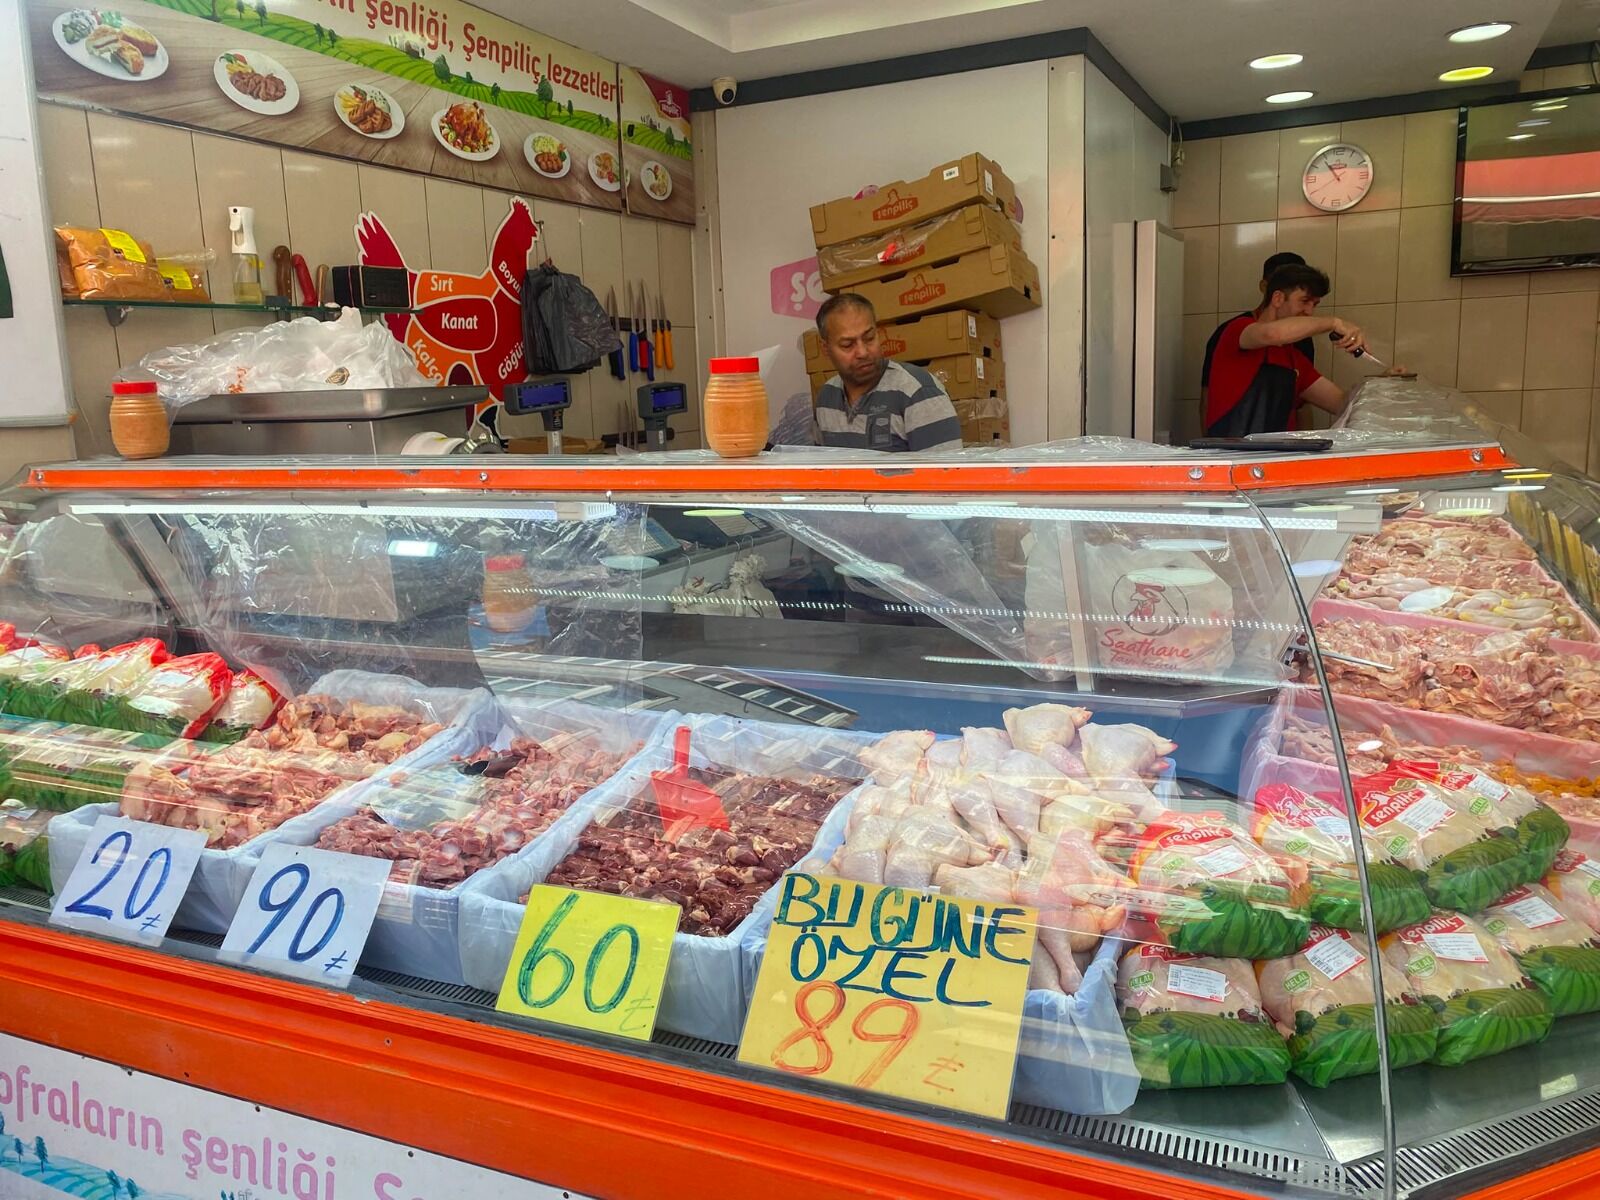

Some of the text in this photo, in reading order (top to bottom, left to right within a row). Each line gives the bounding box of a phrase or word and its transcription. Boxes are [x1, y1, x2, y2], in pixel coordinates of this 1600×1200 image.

[366, 0, 624, 103] şenliği, Şenpiliç lezzetleri
[431, 274, 454, 293] Sırt
[441, 312, 479, 330] Kanat
[1101, 628, 1192, 658] Saathane
[65, 830, 172, 920] 20
[248, 862, 345, 962] 90
[517, 892, 641, 1014] 60
[790, 926, 993, 1008] ÖZEL
[1284, 970, 1310, 991] HELAL
[771, 980, 922, 1089] 89
